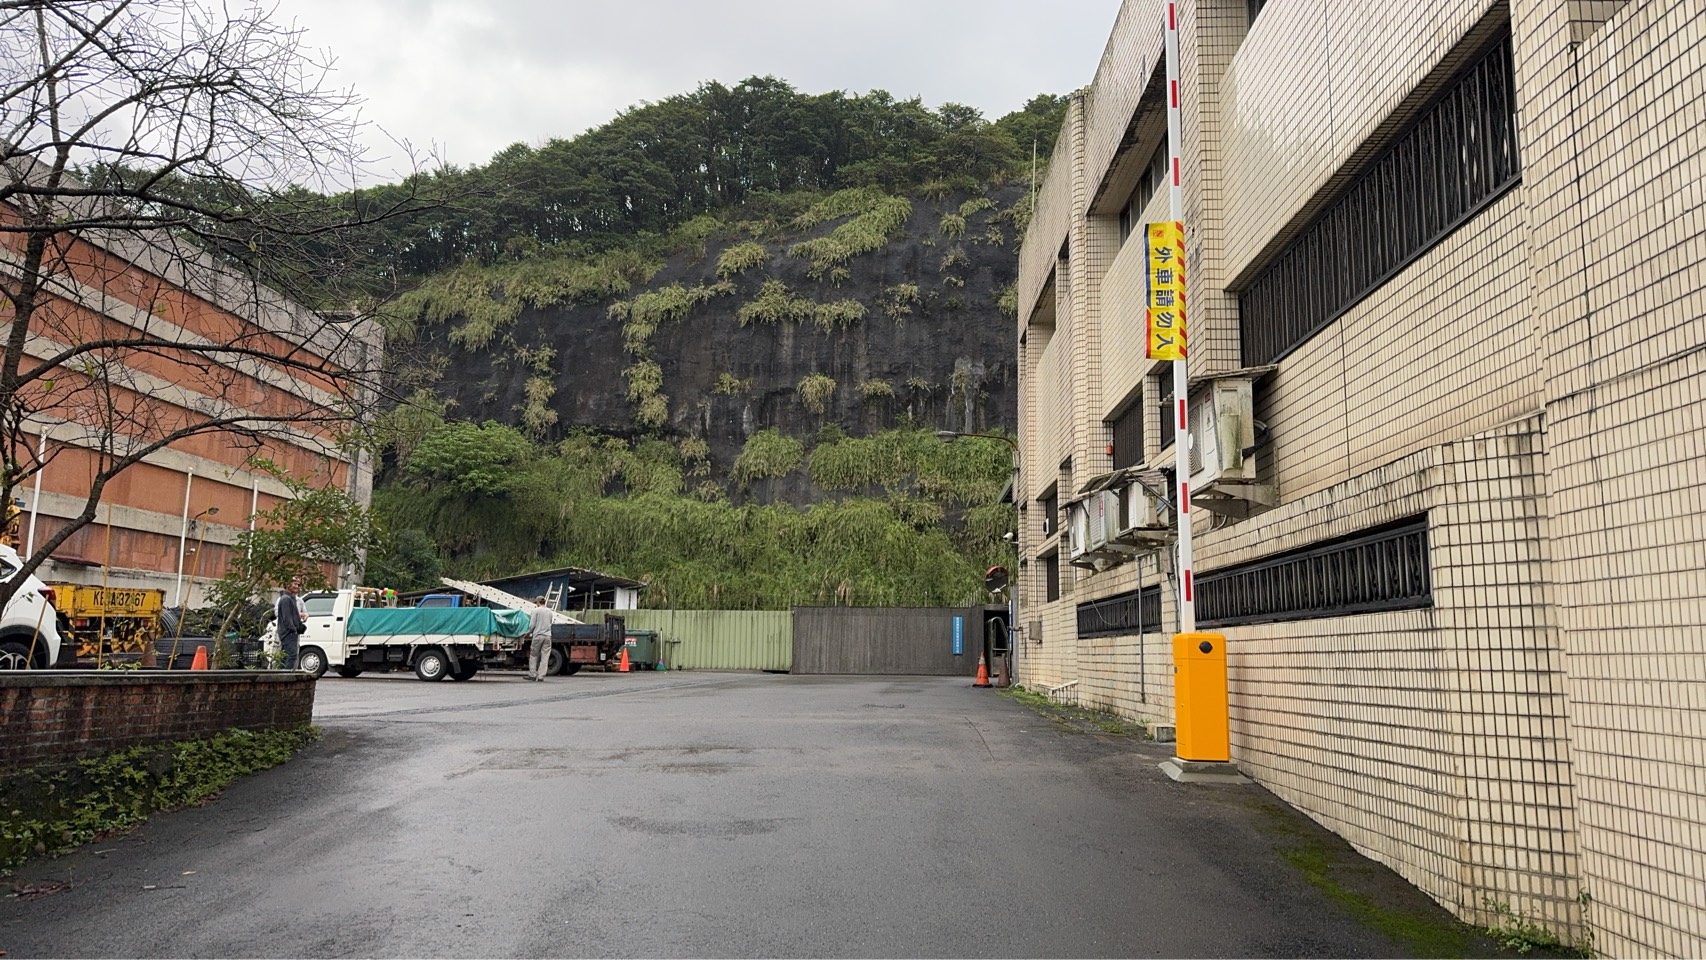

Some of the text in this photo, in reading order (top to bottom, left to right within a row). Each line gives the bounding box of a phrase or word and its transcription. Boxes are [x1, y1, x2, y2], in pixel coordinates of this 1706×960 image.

[1154, 246, 1175, 350] 外車請勿入
